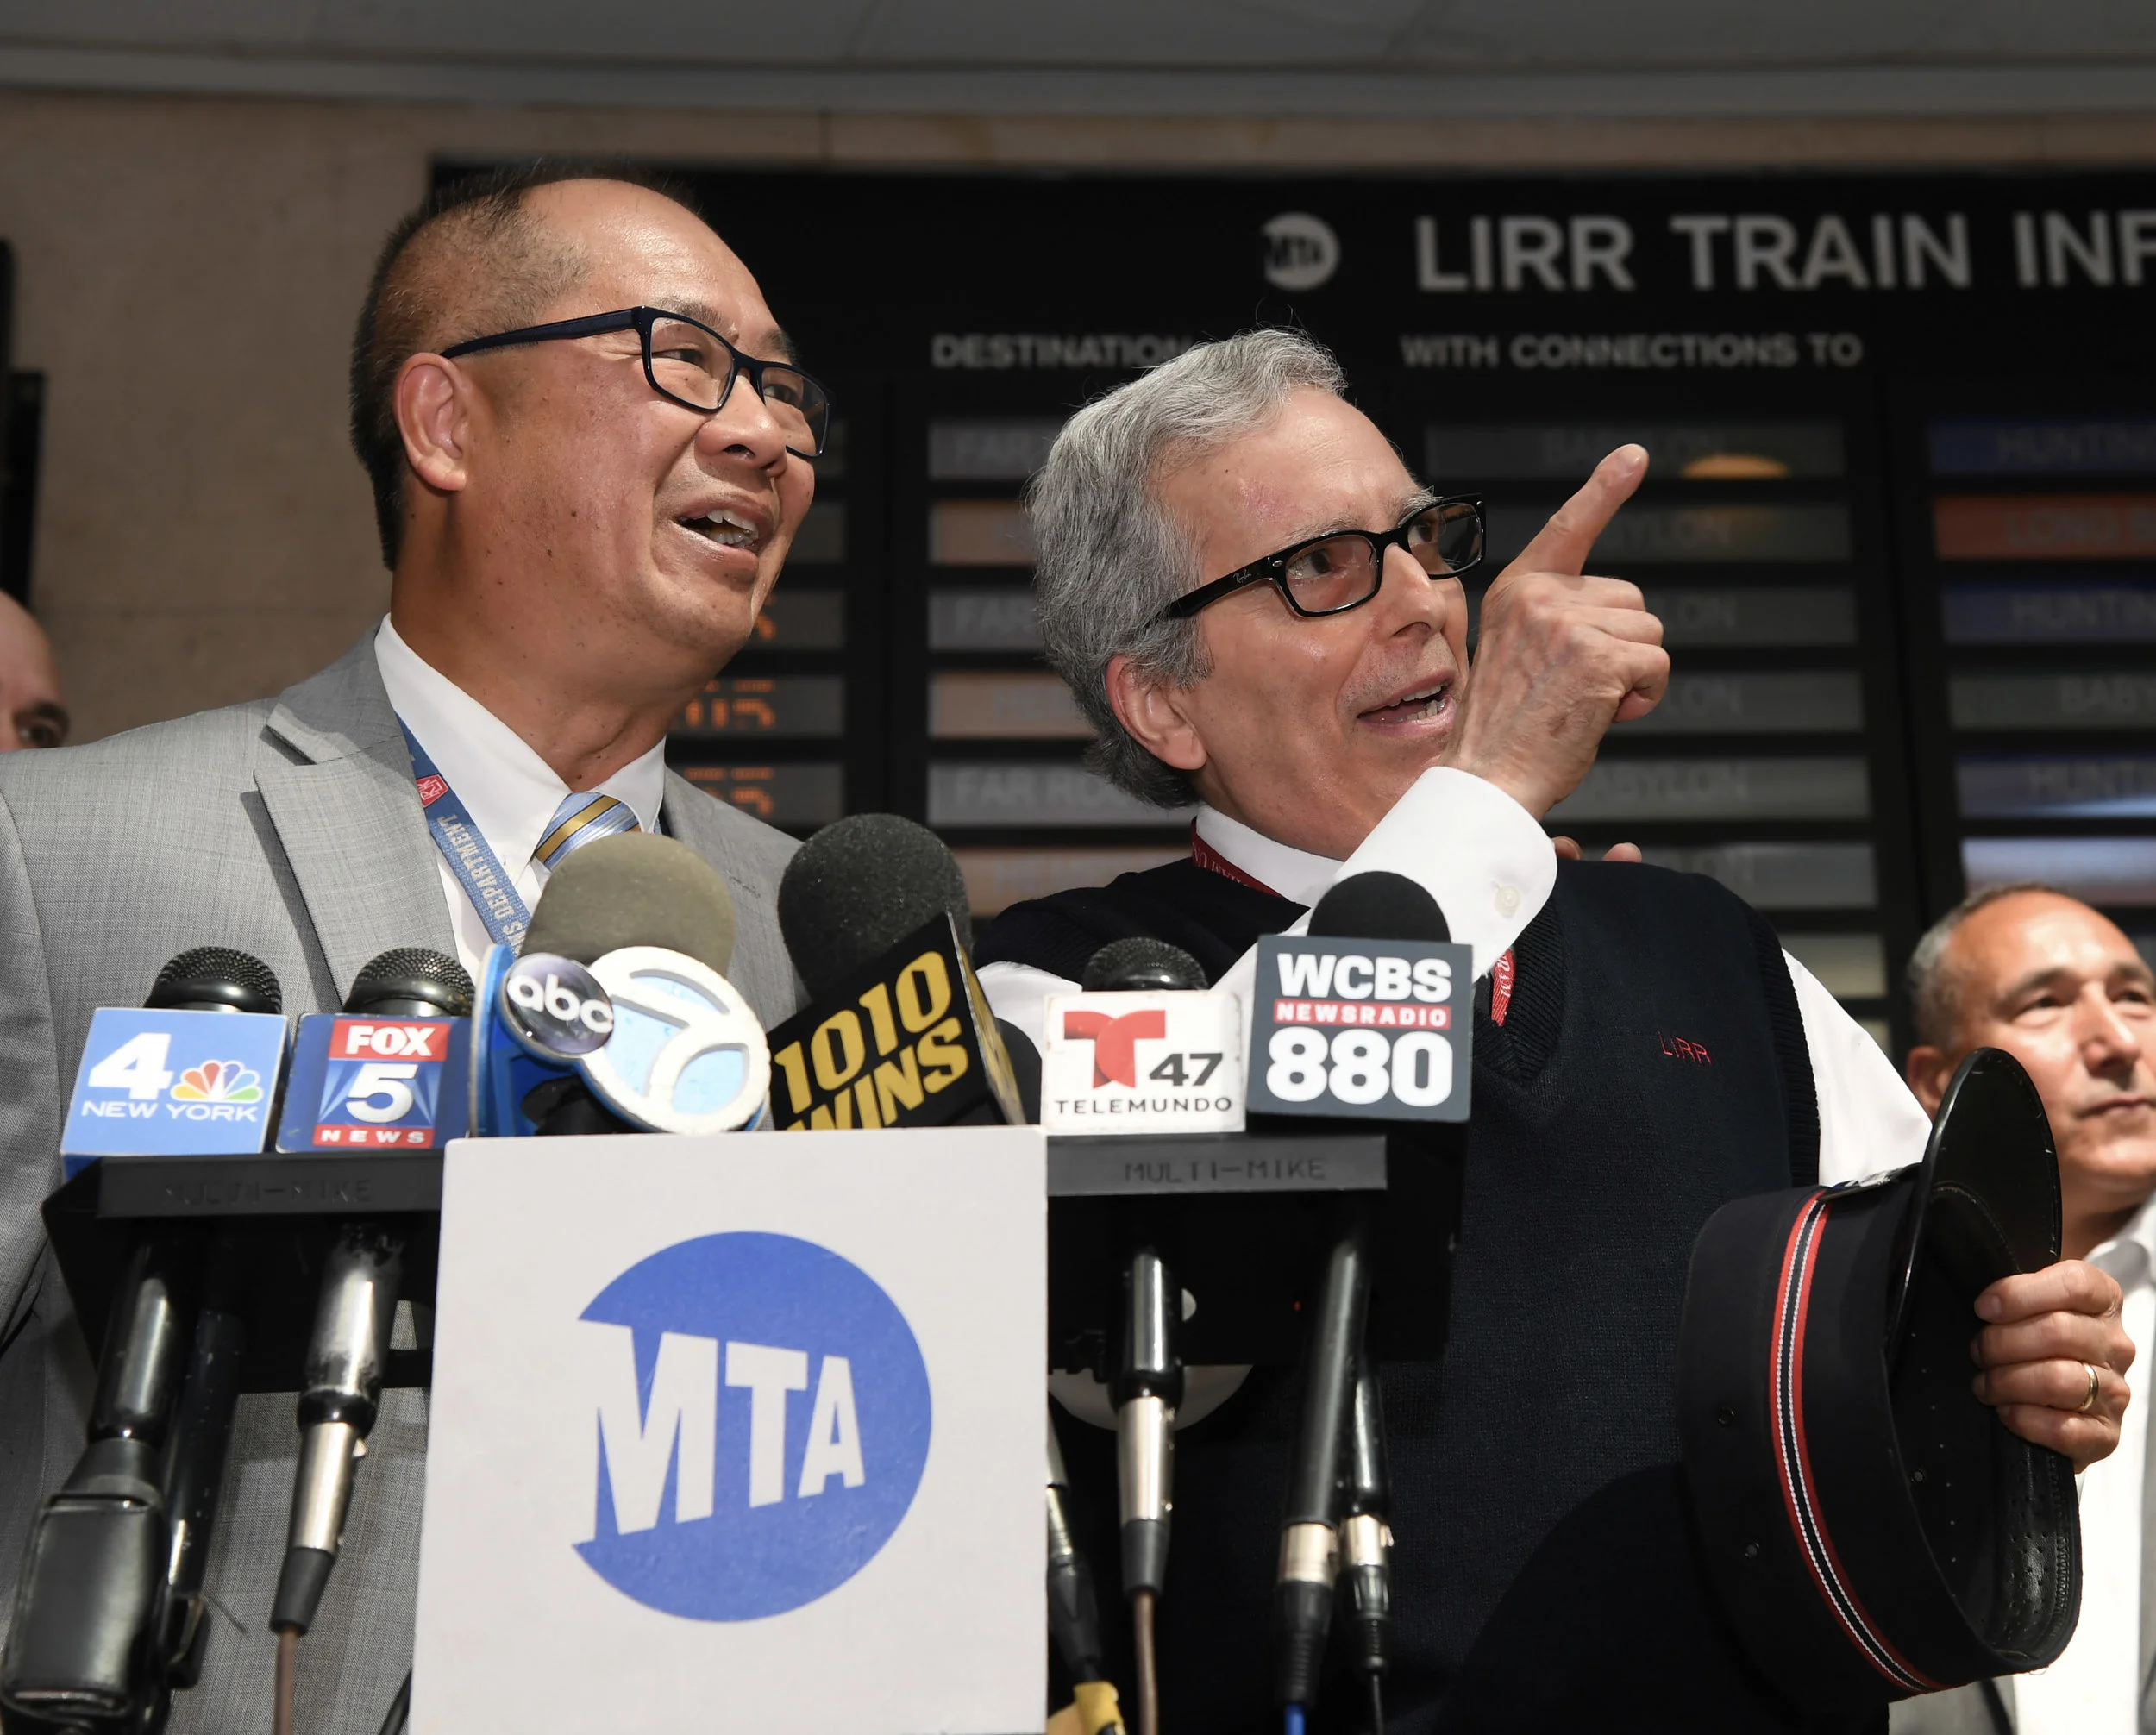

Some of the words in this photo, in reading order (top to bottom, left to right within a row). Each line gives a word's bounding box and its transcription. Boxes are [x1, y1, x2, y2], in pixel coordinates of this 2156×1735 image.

[1413, 214, 1637, 292] LIRR
[1668, 212, 1973, 291] TRAIN
[1399, 334, 1499, 368] WITH
[1509, 333, 1800, 369] CONNECTIONS
[1806, 332, 1864, 367] TO
[437, 814, 515, 920] DEPARTMENT
[1276, 953, 1452, 1003] WCBS
[507, 974, 614, 1034] abc
[1277, 1003, 1447, 1027] NEWSRADIO
[345, 1025, 436, 1057] FOX
[774, 951, 951, 1114] 1010
[1658, 1030, 1714, 1067] LIRR
[88, 1032, 173, 1100] 4
[1149, 1052, 1223, 1087] 47
[1265, 1026, 1453, 1107] 880
[82, 1101, 159, 1119] NEW
[165, 1103, 258, 1122] YORK
[345, 1063, 420, 1124] 5
[1054, 1097, 1232, 1115] TELEMUNDO
[320, 1128, 426, 1144] NEWS
[1124, 1158, 1327, 1184] MULTI-MIKE
[581, 1318, 866, 1548] MTA
